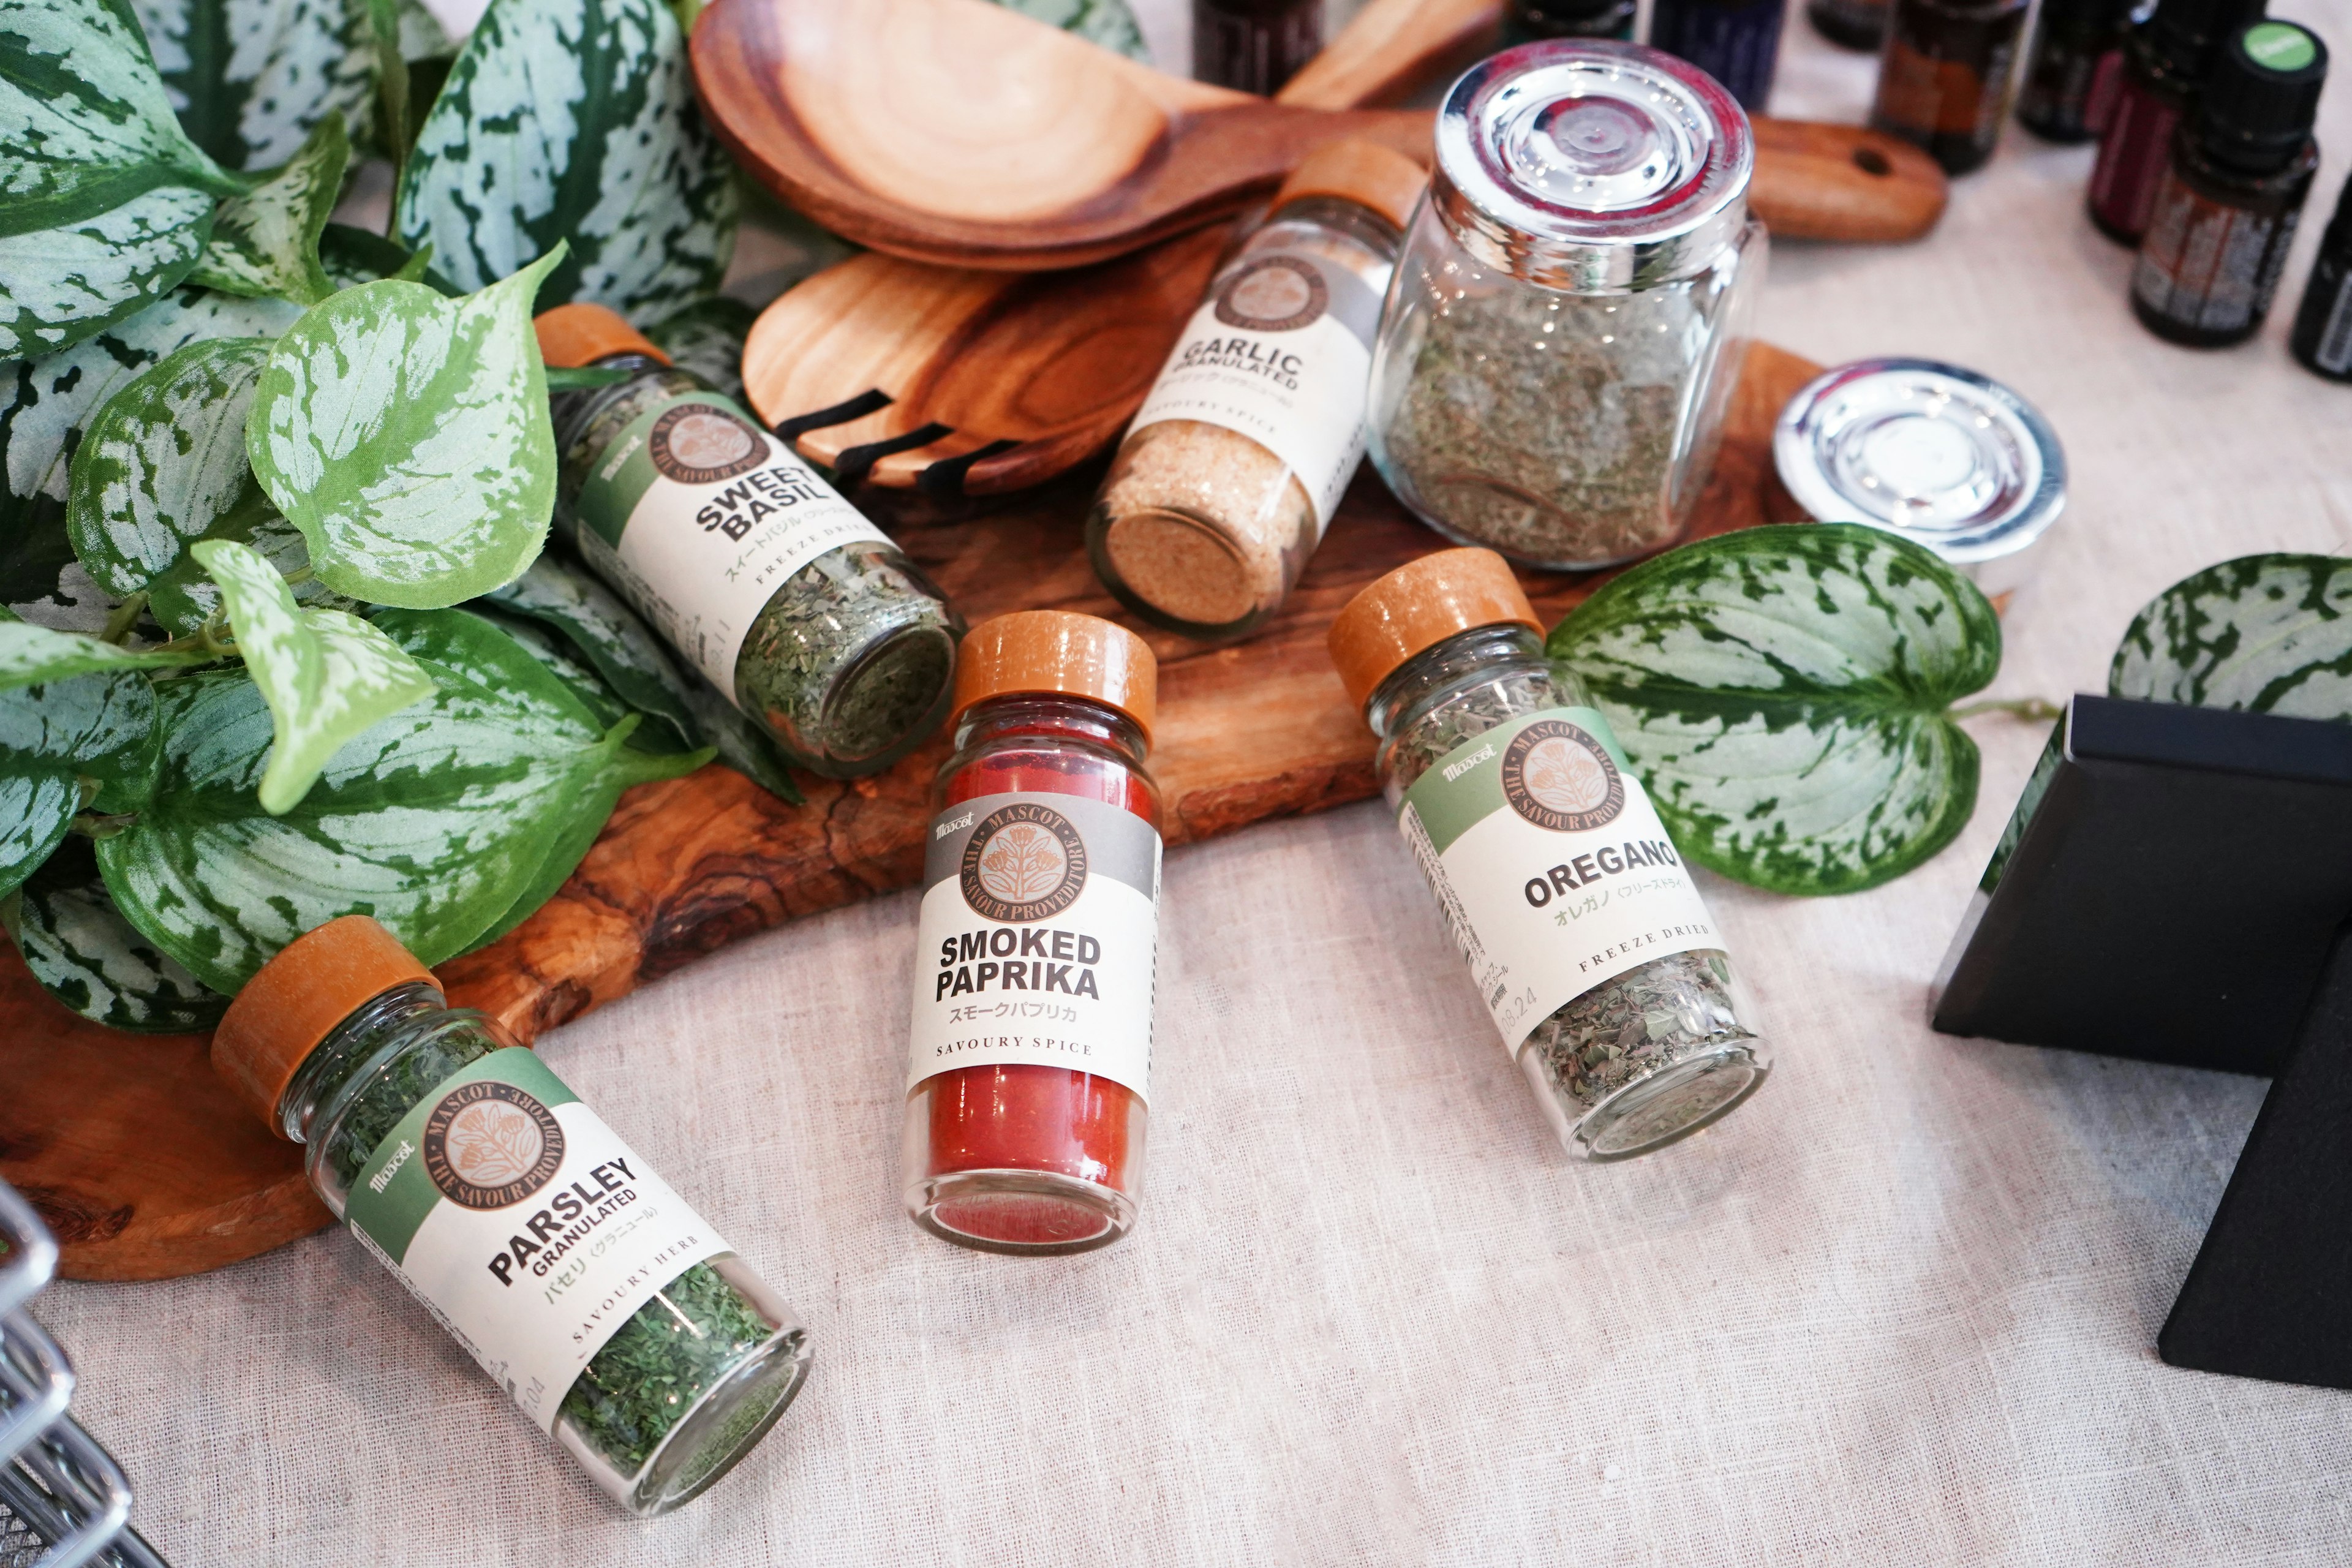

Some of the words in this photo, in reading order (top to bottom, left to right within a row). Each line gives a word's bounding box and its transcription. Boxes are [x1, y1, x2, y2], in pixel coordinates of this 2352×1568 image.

[1184, 338, 1303, 375] GARLIC
[696, 467, 812, 532] SWEET
[721, 484, 829, 543] BASIL
[755, 535, 819, 585] FREEZE
[1513, 722, 1581, 753] MASCOT
[1443, 743, 1497, 782] Mascot
[989, 805, 1065, 831] MASCOT
[1505, 764, 1526, 801] THE
[1518, 799, 1580, 829] SAVOUR
[936, 812, 975, 841] Mascot
[963, 838, 984, 874] THE
[1010, 837, 1085, 920] PROVEDITORE
[1525, 840, 1678, 908] OREGANO
[965, 875, 1008, 919] SAVOUR
[1554, 890, 1610, 927] オレガノ
[940, 928, 1101, 968] SMOKED
[1578, 932, 1657, 973] FREEZE
[1662, 924, 1709, 940] DRIED
[936, 960, 1100, 1003] PAPRIKA
[949, 1001, 1077, 1024] スモークパプリカ
[937, 1036, 1024, 1057] SAVOURY
[1033, 1037, 1092, 1057] SPICE
[429, 1083, 495, 1137] MASCOT
[369, 1139, 416, 1194] Mascot
[429, 1151, 458, 1193] THE
[456, 1181, 526, 1207] SAVOUR
[508, 1089, 563, 1191] PROVEDITORE
[488, 1157, 637, 1288] PARSLEY
[532, 1188, 637, 1277] GRANULATED
[573, 1265, 651, 1344] SAVOURY
[654, 1235, 699, 1266] HERB
